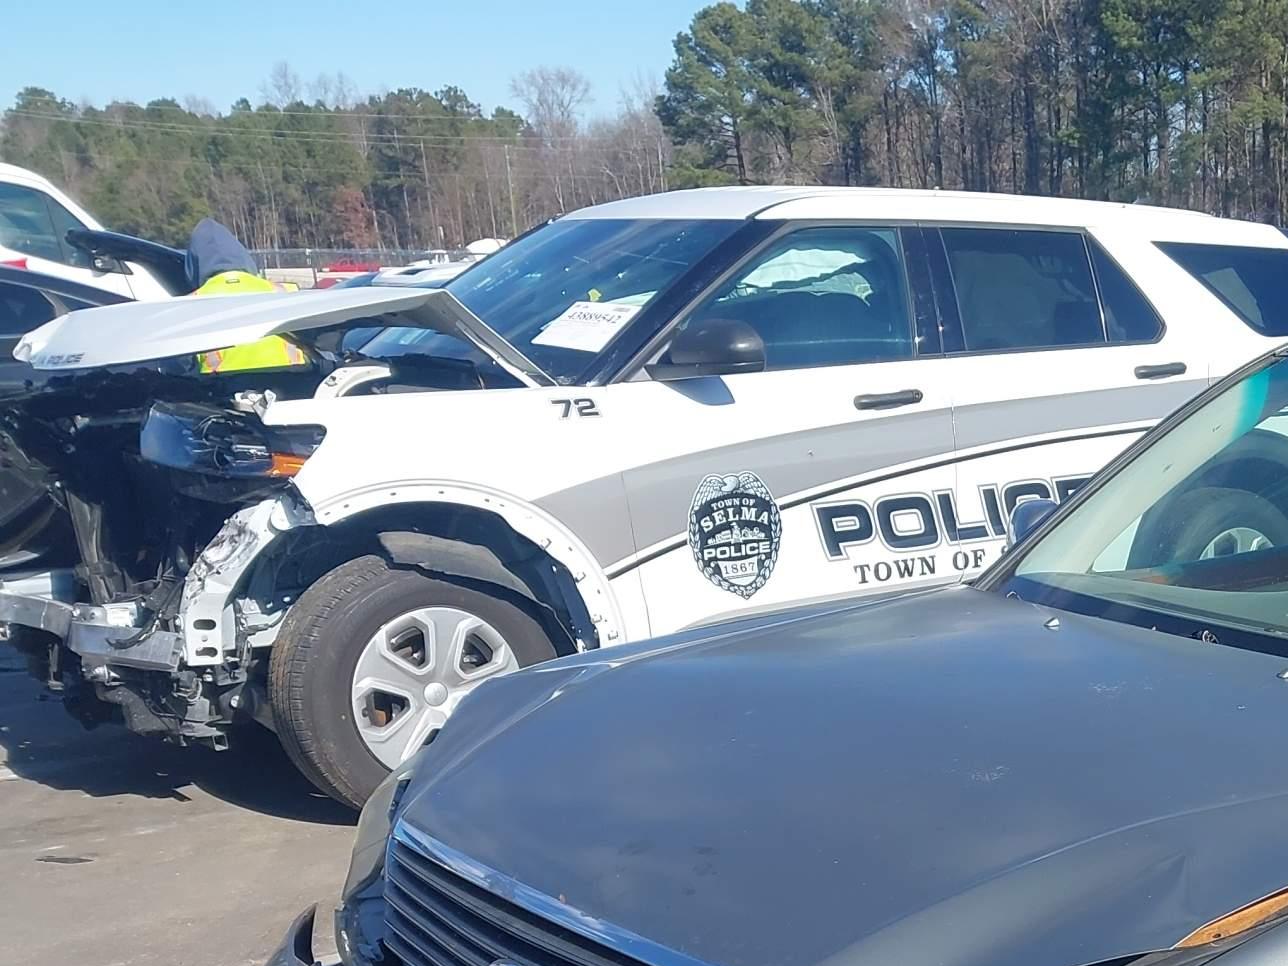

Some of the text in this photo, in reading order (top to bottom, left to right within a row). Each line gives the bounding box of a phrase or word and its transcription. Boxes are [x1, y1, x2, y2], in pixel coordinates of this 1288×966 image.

[550, 398, 601, 418] 72
[711, 497, 757, 511] TOWN OF
[700, 507, 769, 533] SELMA
[703, 541, 771, 561] POLICE
[723, 562, 756, 575] 1867
[854, 555, 937, 584] TOWN
[952, 549, 986, 571] OF
